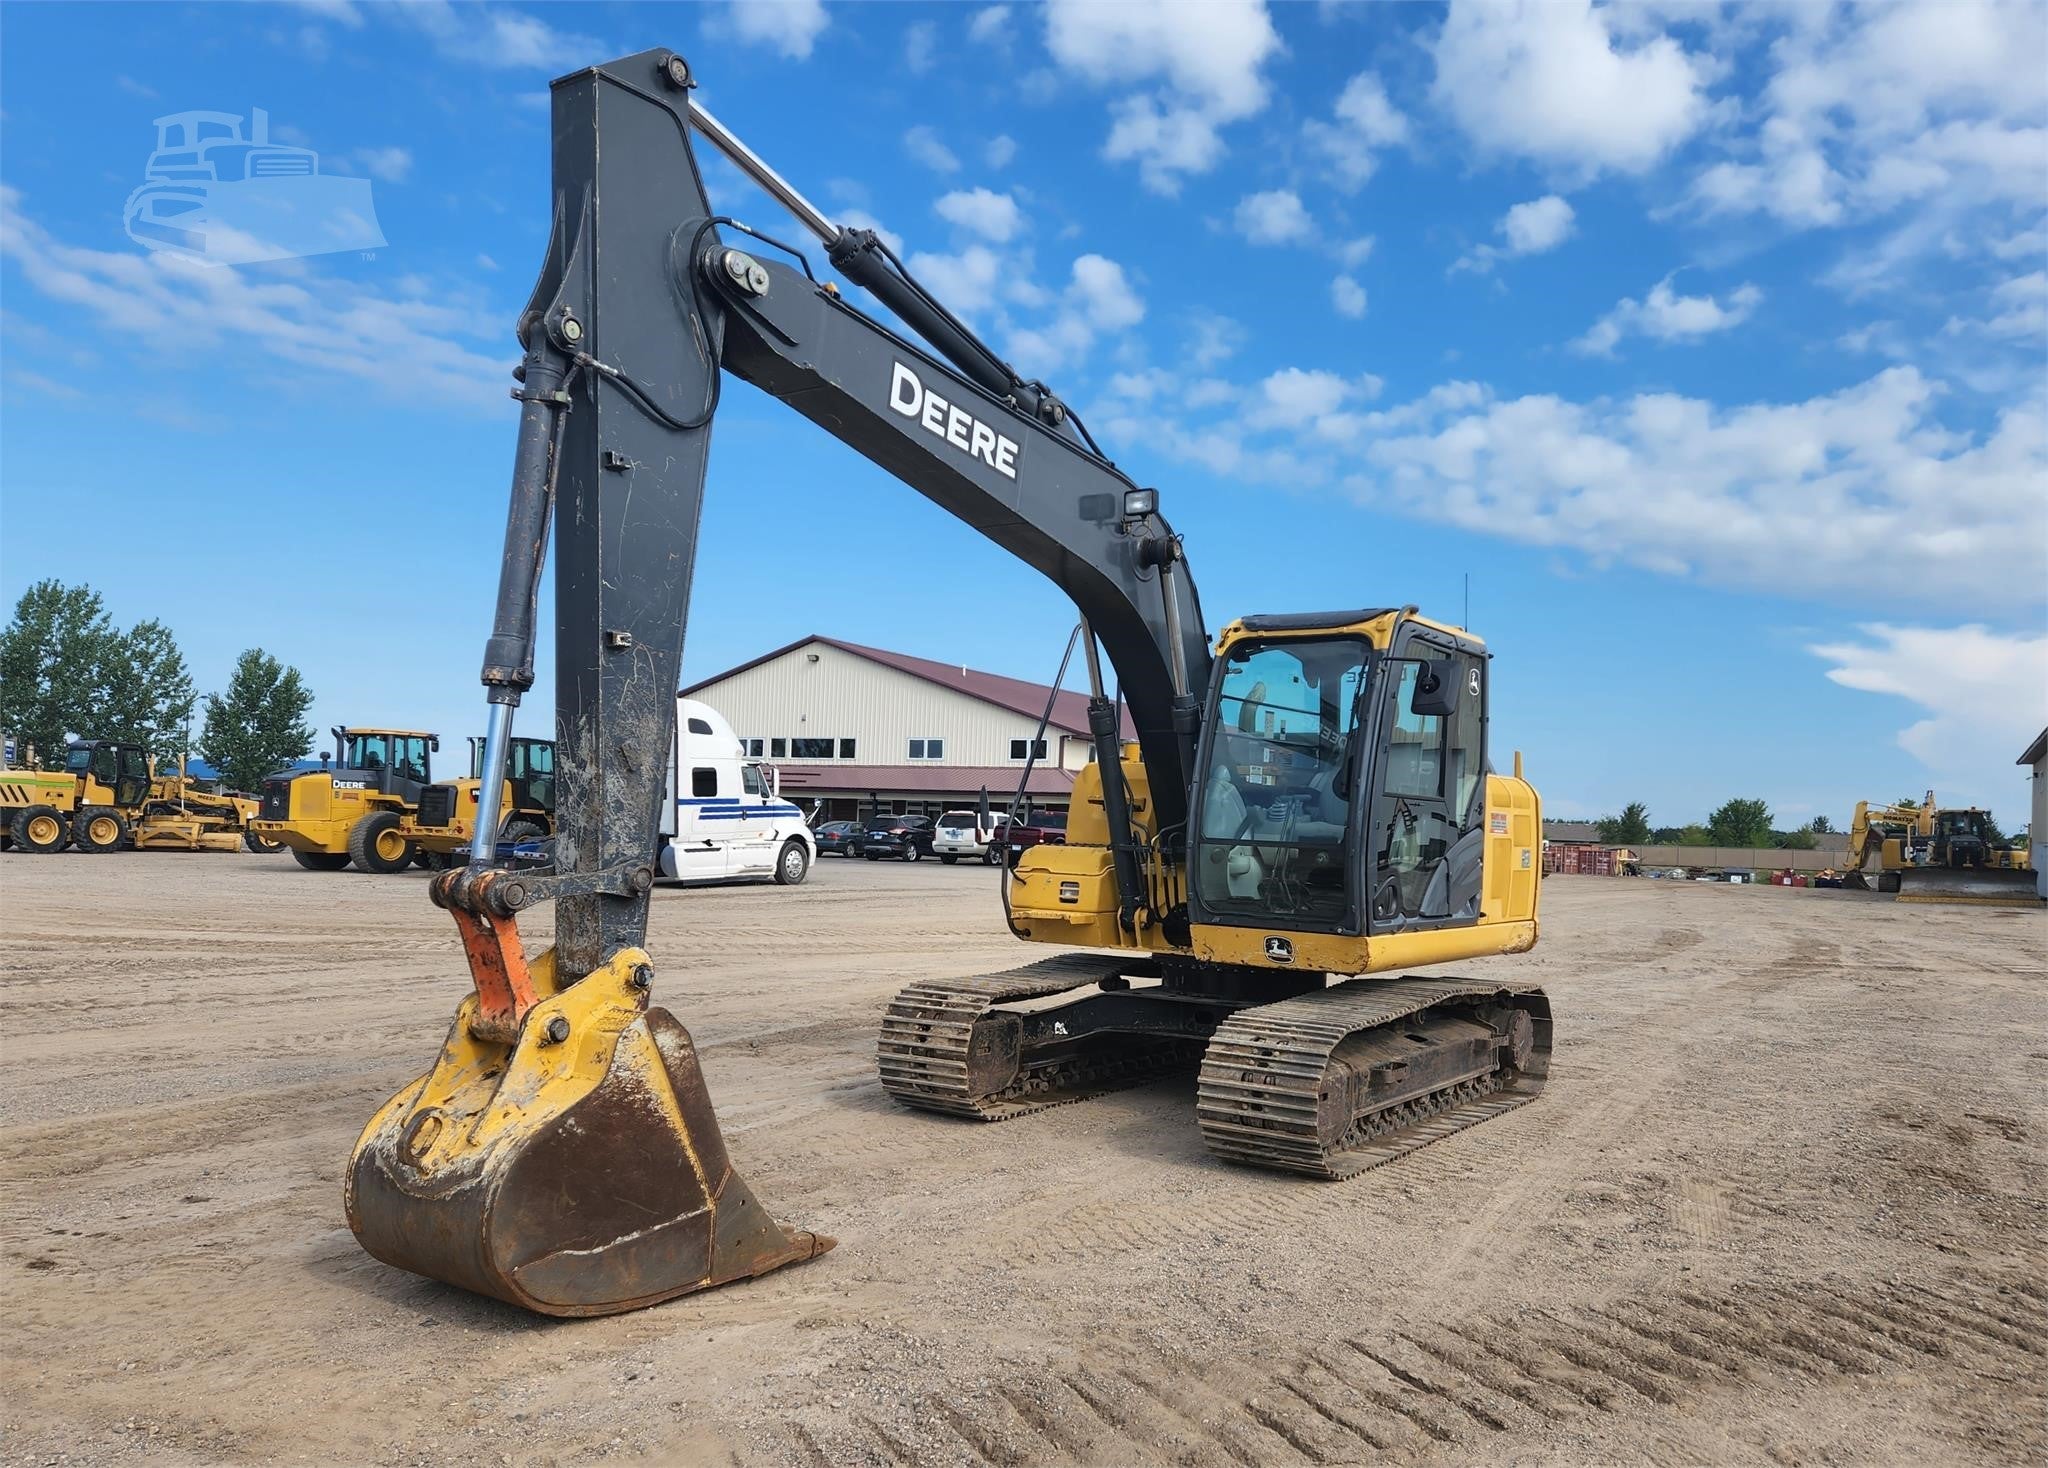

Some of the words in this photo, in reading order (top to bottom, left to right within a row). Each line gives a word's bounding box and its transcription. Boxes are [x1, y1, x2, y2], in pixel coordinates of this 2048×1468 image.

[889, 361, 1019, 479] DEERE
[333, 779, 366, 789] DEERE
[1883, 814, 1914, 823] KOMATSU
